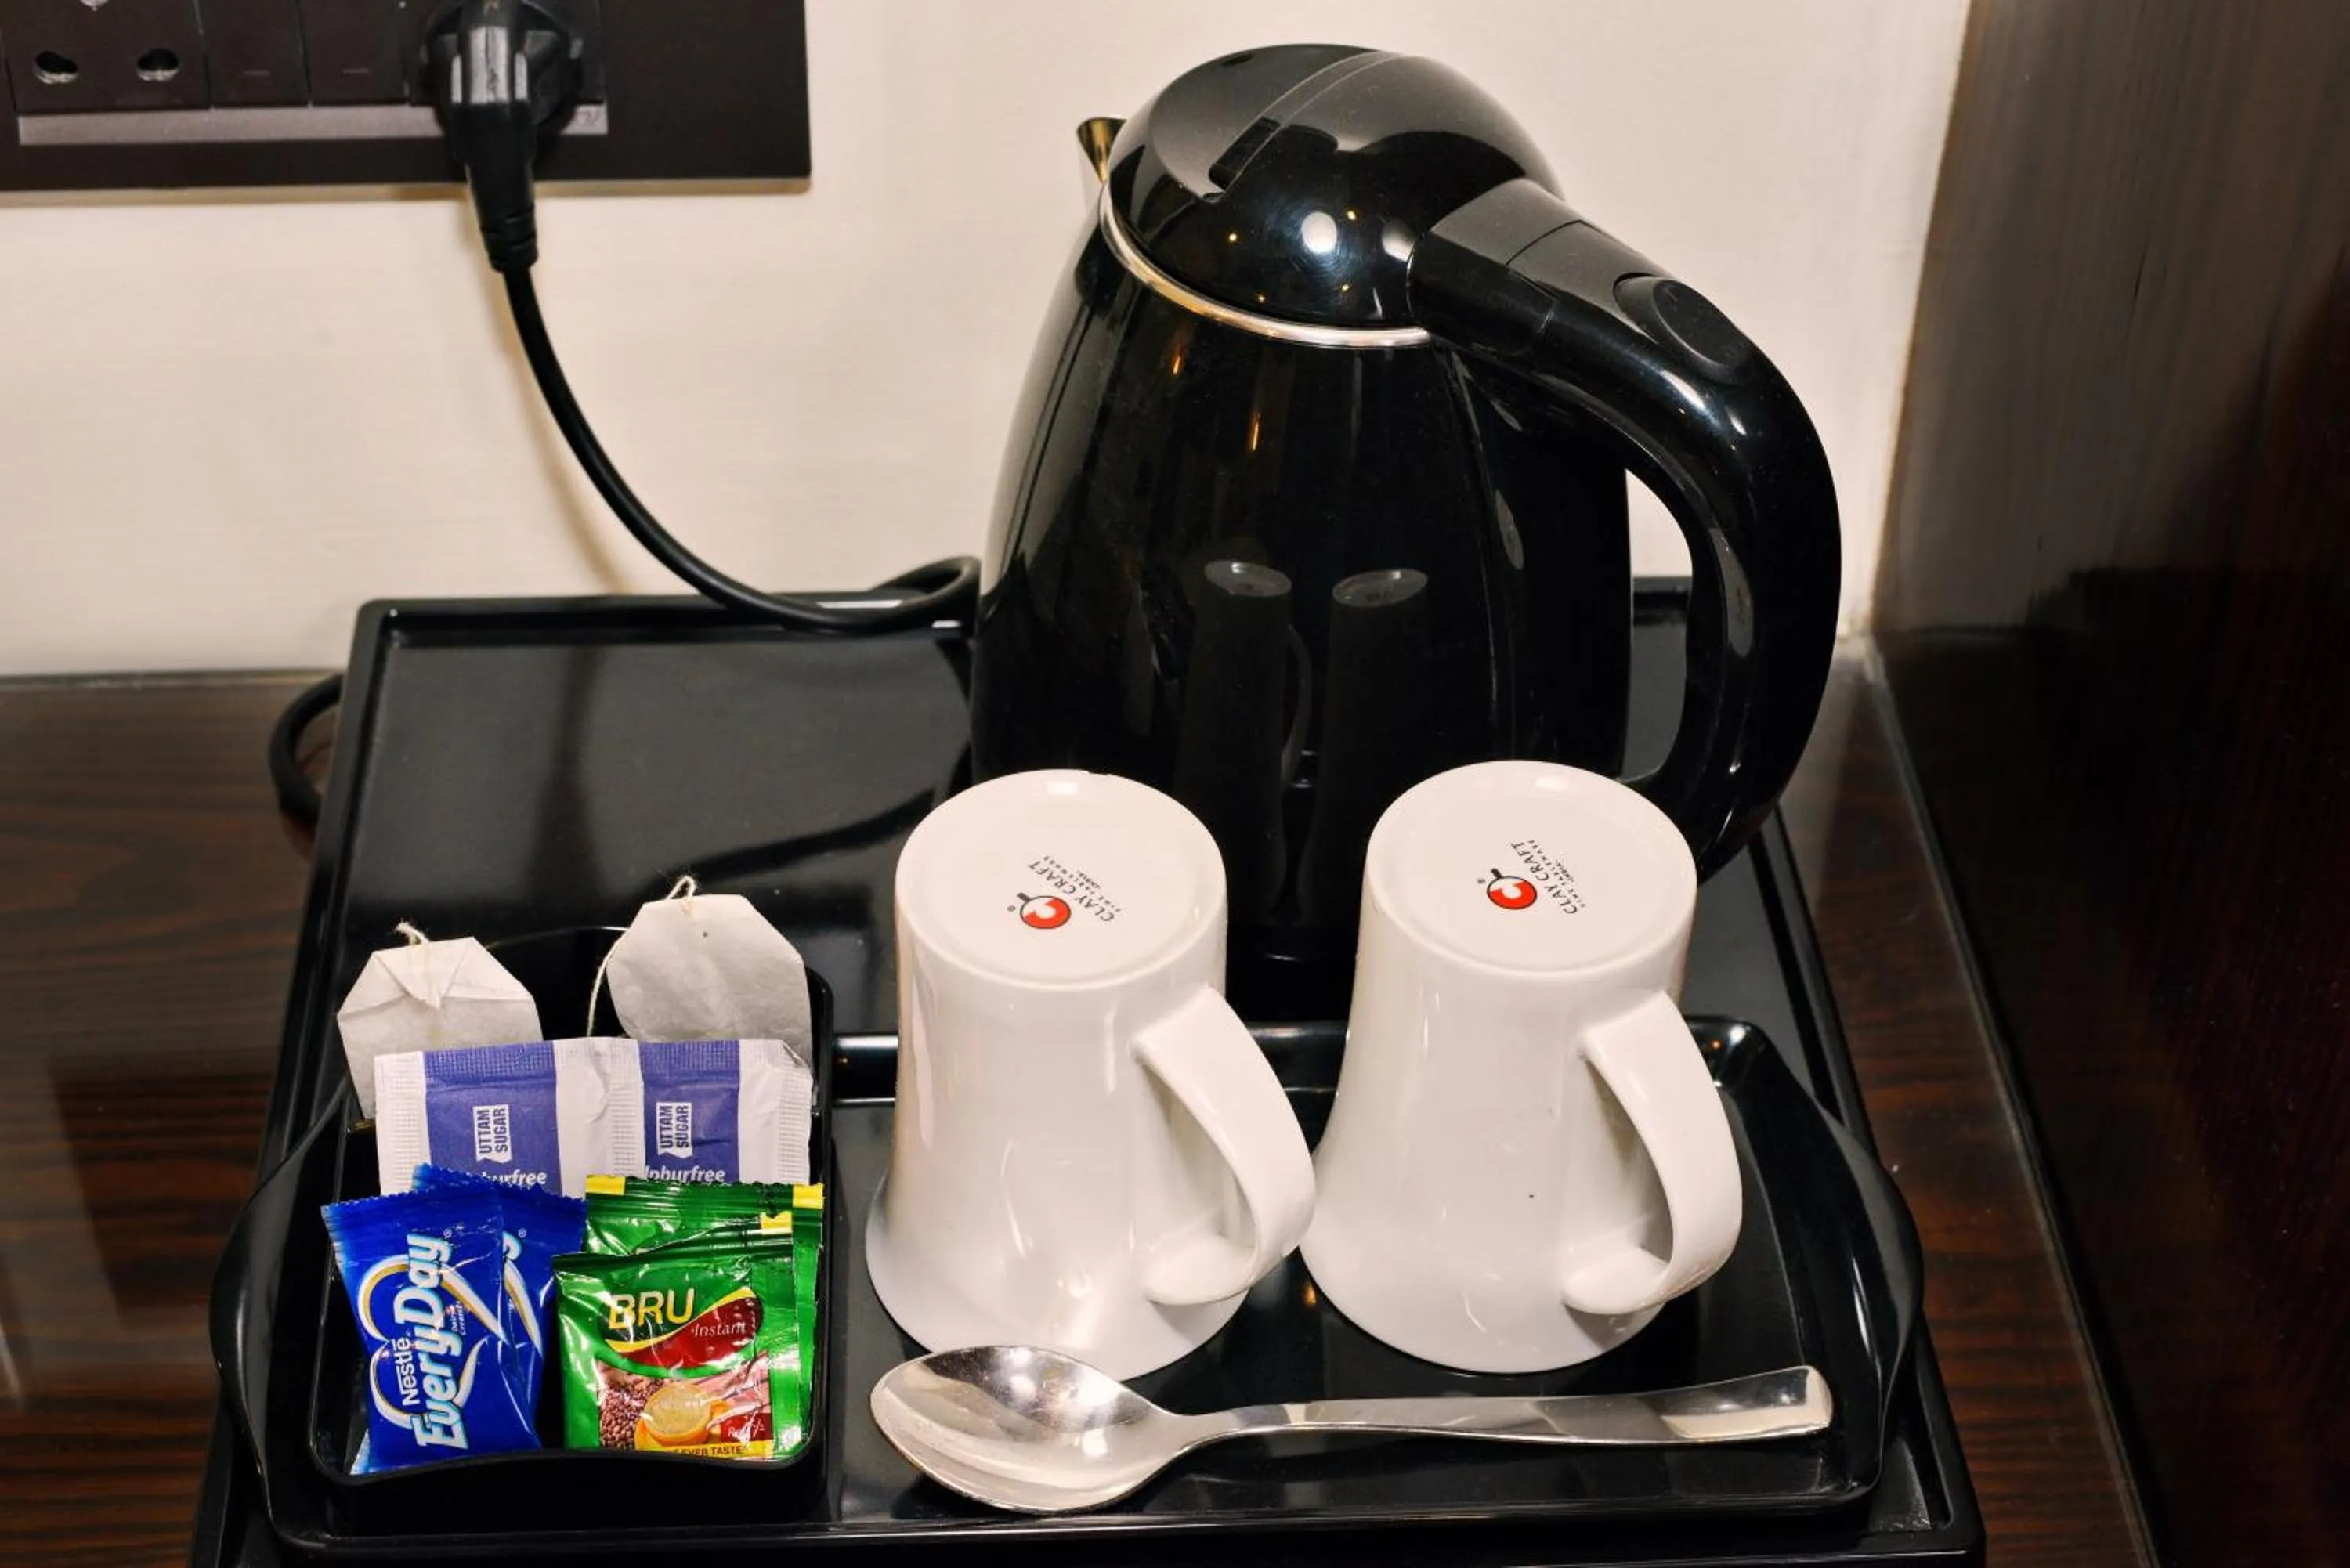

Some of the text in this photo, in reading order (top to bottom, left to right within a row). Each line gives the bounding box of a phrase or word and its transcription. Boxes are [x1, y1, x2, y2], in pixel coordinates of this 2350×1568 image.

[1028, 861, 1115, 922] CLAY CRAFT
[1511, 842, 1578, 914] CLAY CRAFT
[476, 1109, 493, 1154] UTTAM
[493, 1107, 508, 1153] SUGAR
[660, 1104, 674, 1149] UTTAM
[675, 1104, 689, 1149] SUGAR
[608, 1288, 696, 1330] BRU
[692, 1321, 747, 1338] Instant
[393, 1232, 469, 1450] EveryDay
[392, 1337, 421, 1407] Nestlé
